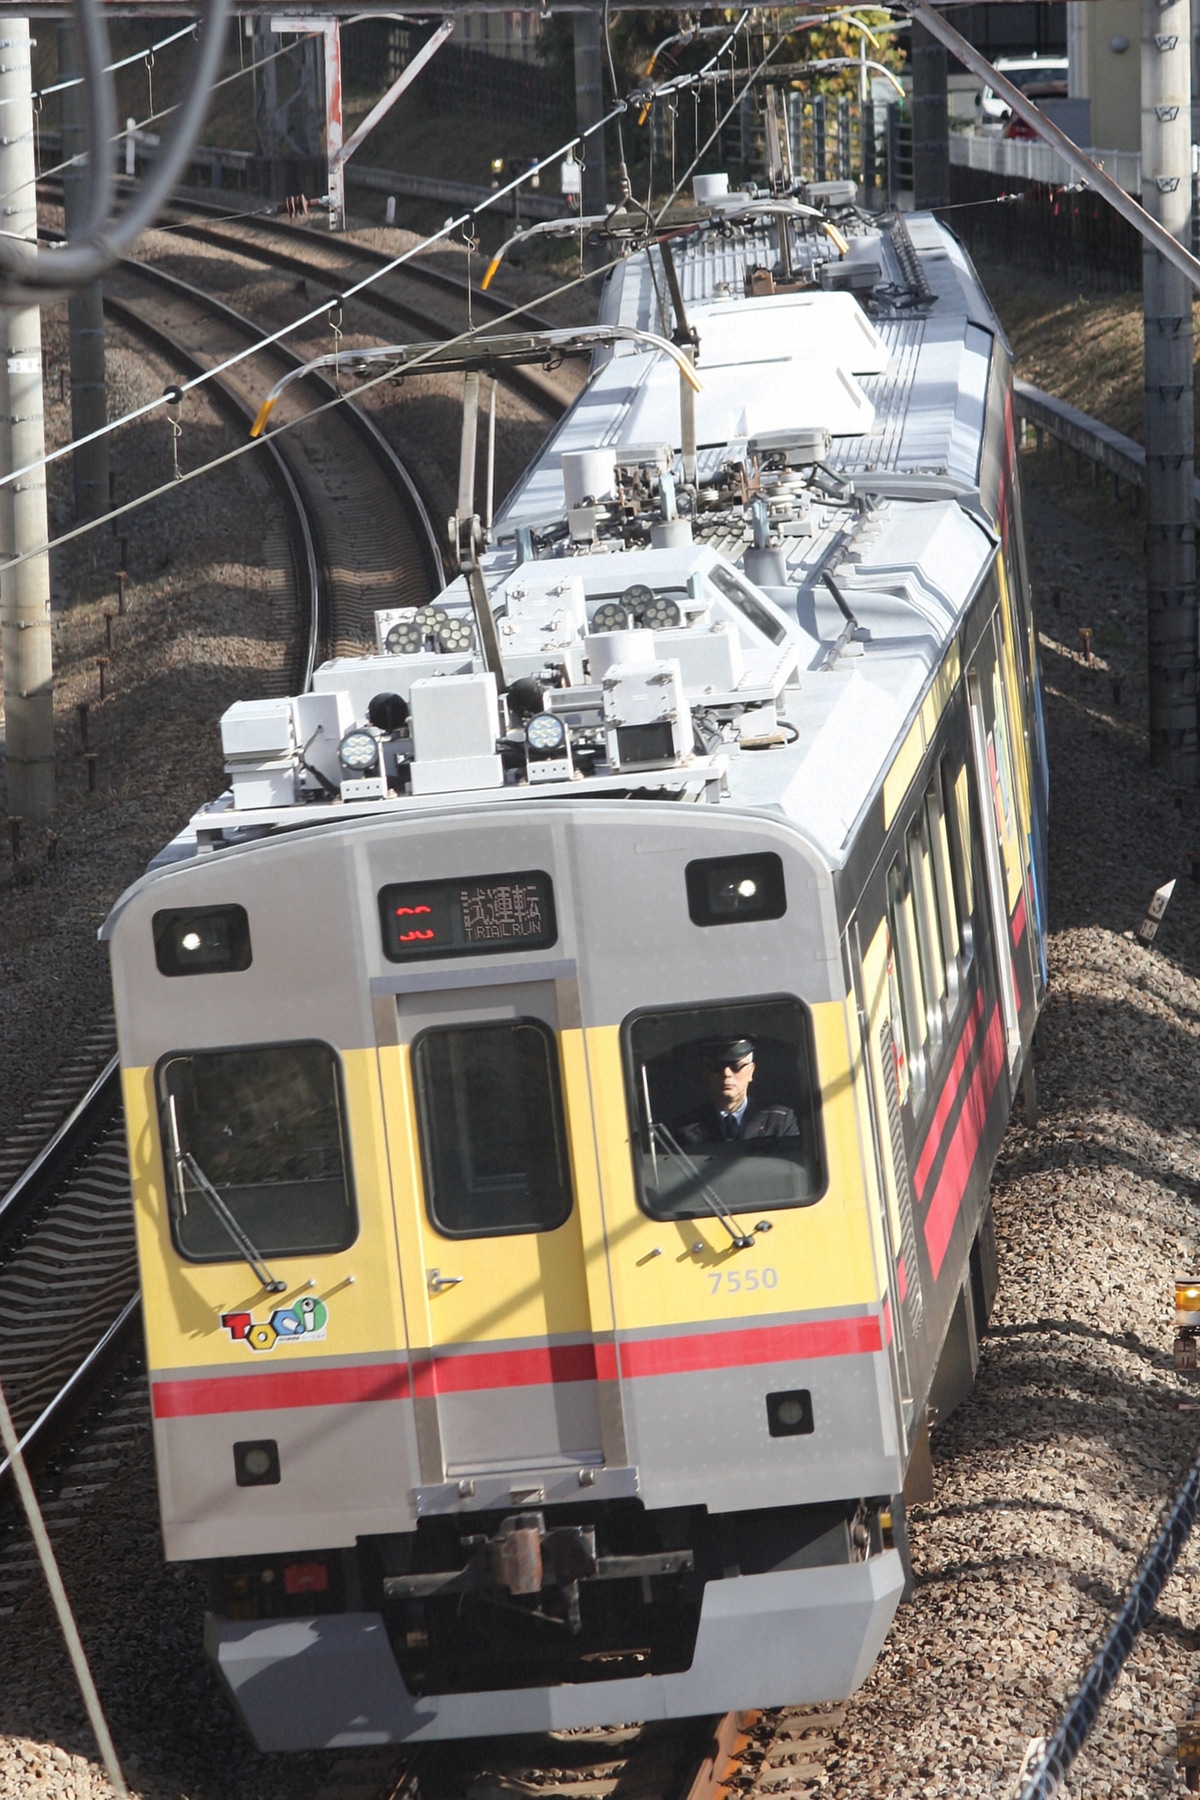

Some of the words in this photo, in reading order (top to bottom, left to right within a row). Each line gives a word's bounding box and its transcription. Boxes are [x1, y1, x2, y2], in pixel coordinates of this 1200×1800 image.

[461, 885, 541, 928] 試運転
[1153, 897, 1164, 914] 3
[465, 924, 511, 941] TRIAL
[513, 921, 542, 936] RUN
[707, 1267, 778, 1295] 7550
